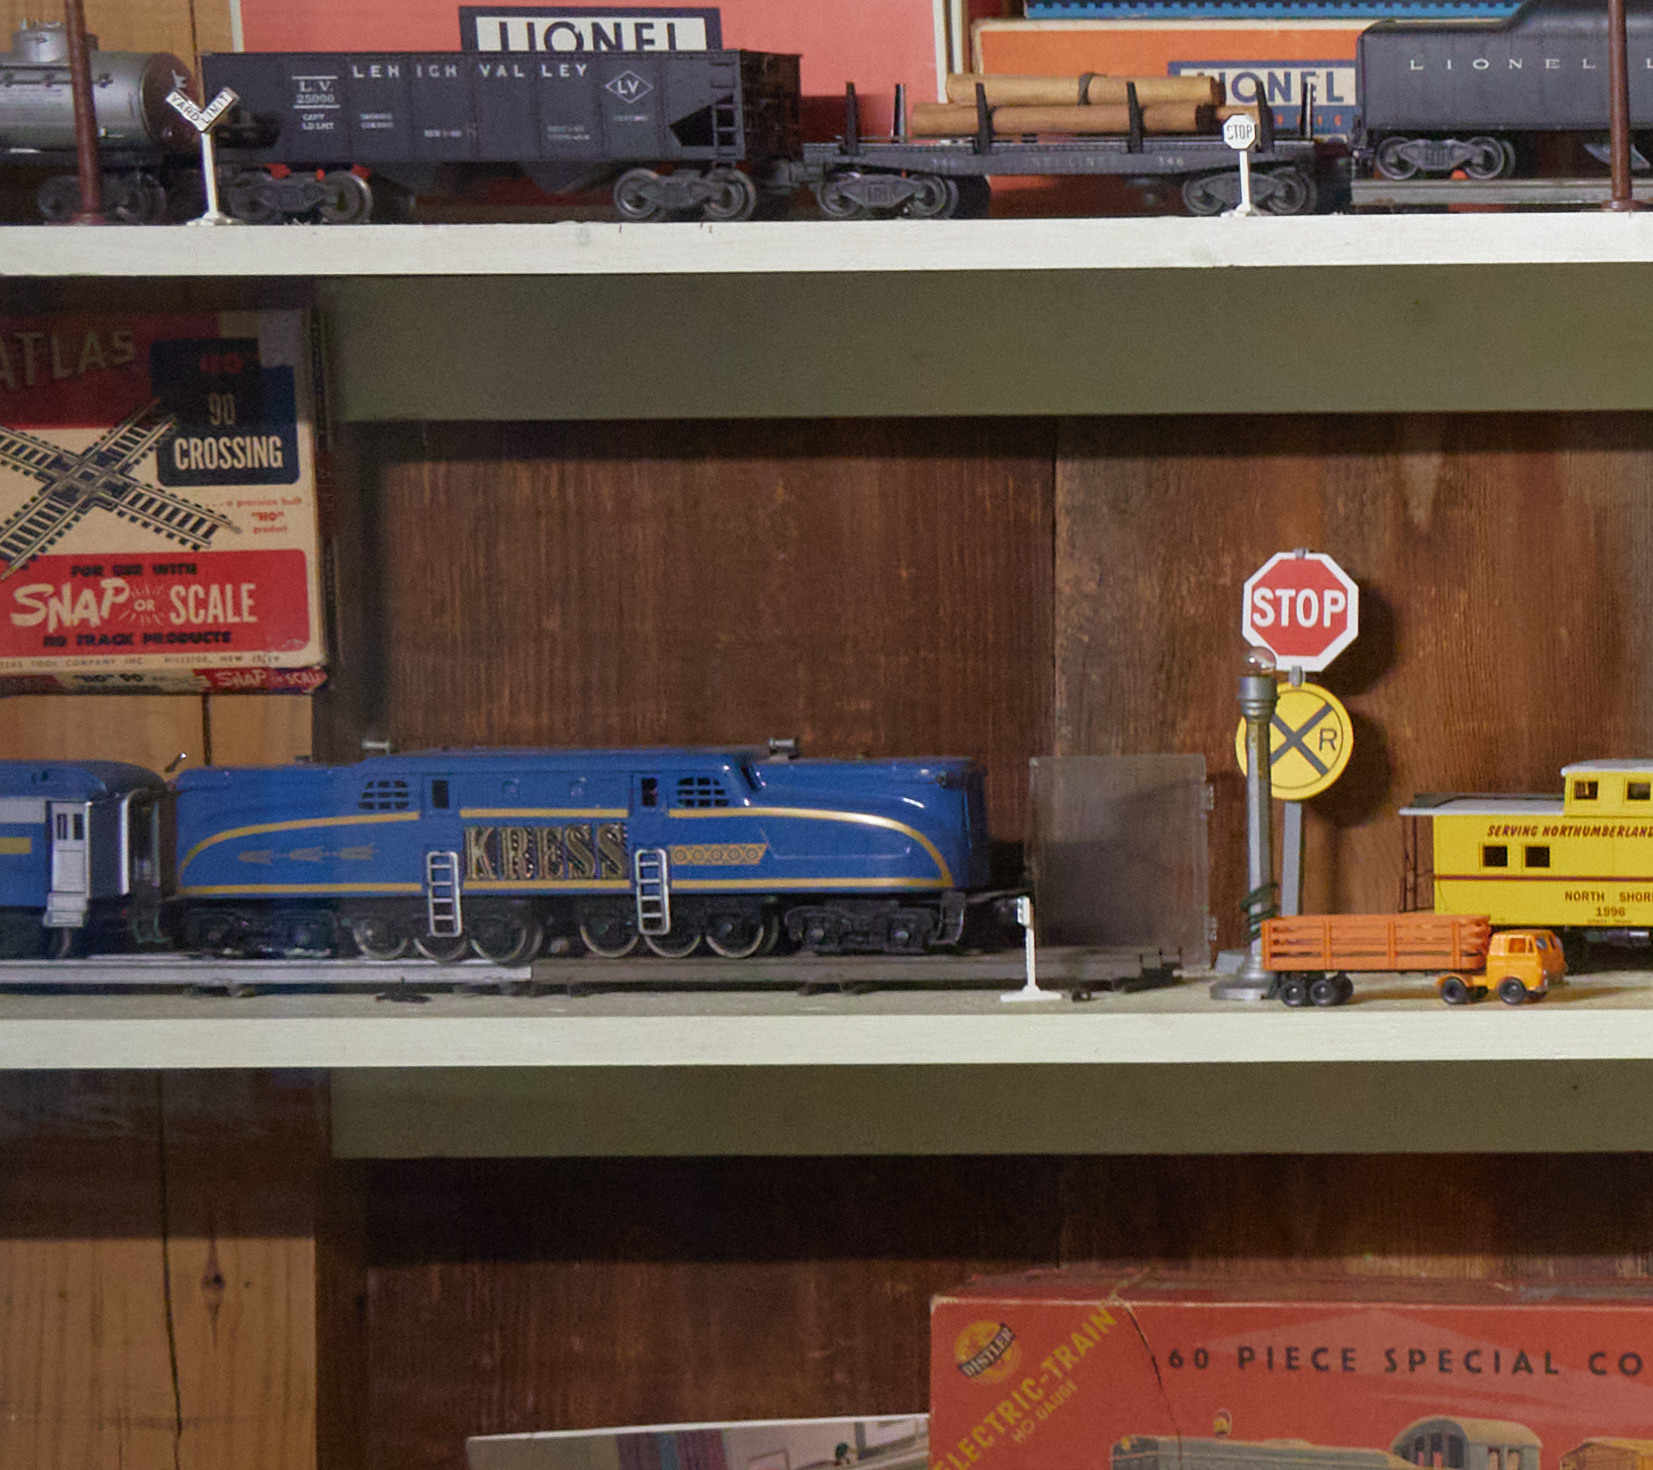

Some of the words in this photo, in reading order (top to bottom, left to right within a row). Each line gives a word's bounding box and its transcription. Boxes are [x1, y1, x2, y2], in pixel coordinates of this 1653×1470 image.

[353, 64, 458, 79] LEHIGH
[480, 62, 588, 79] VALLEY
[1408, 57, 1598, 72] LIONEL
[296, 94, 336, 104] 25000
[616, 80, 639, 95] LV
[170, 94, 200, 121] YARD
[202, 94, 229, 123] LIMIT
[1225, 124, 1254, 140] STOP
[208, 392, 236, 426] 90
[174, 435, 284, 471] CROSSING
[10, 576, 130, 634] SNAP
[134, 598, 156, 613] OR
[169, 583, 258, 625] SCALE
[1251, 587, 1346, 629] STOP
[1318, 728, 1337, 751] R
[1487, 825, 1538, 838] SERVING
[463, 824, 631, 881] KRESS
[1564, 891, 1605, 903] NORTH
[1596, 906, 1627, 918] 1996
[960, 1323, 1015, 1377] DISTLER
[1168, 1347, 1210, 1370] 60
[1237, 1346, 1358, 1372] PIECE
[1384, 1348, 1561, 1377] SPECIAL
[1012, 1418, 1037, 1444] HO
[1036, 1379, 1078, 1421] GAUGE
